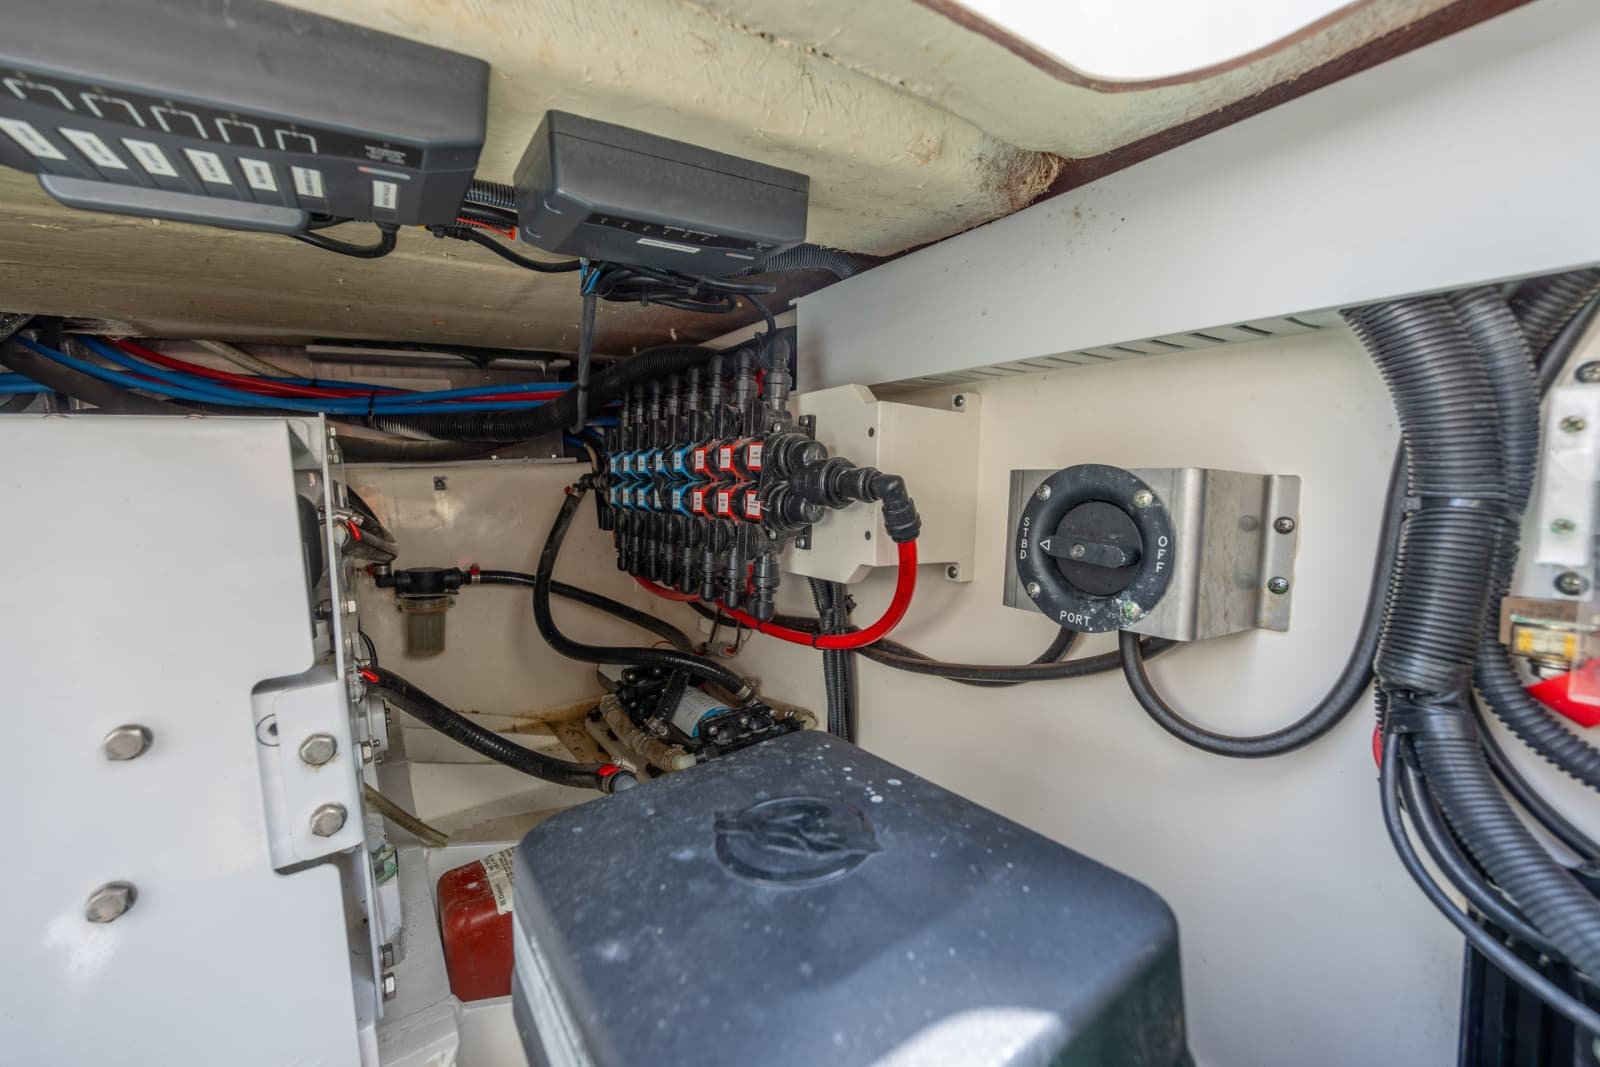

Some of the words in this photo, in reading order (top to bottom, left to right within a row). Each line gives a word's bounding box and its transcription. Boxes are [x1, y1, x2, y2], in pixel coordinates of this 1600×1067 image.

[1019, 516, 1030, 559] STBD
[1156, 536, 1168, 573] OFF
[1060, 610, 1091, 626] PORT
